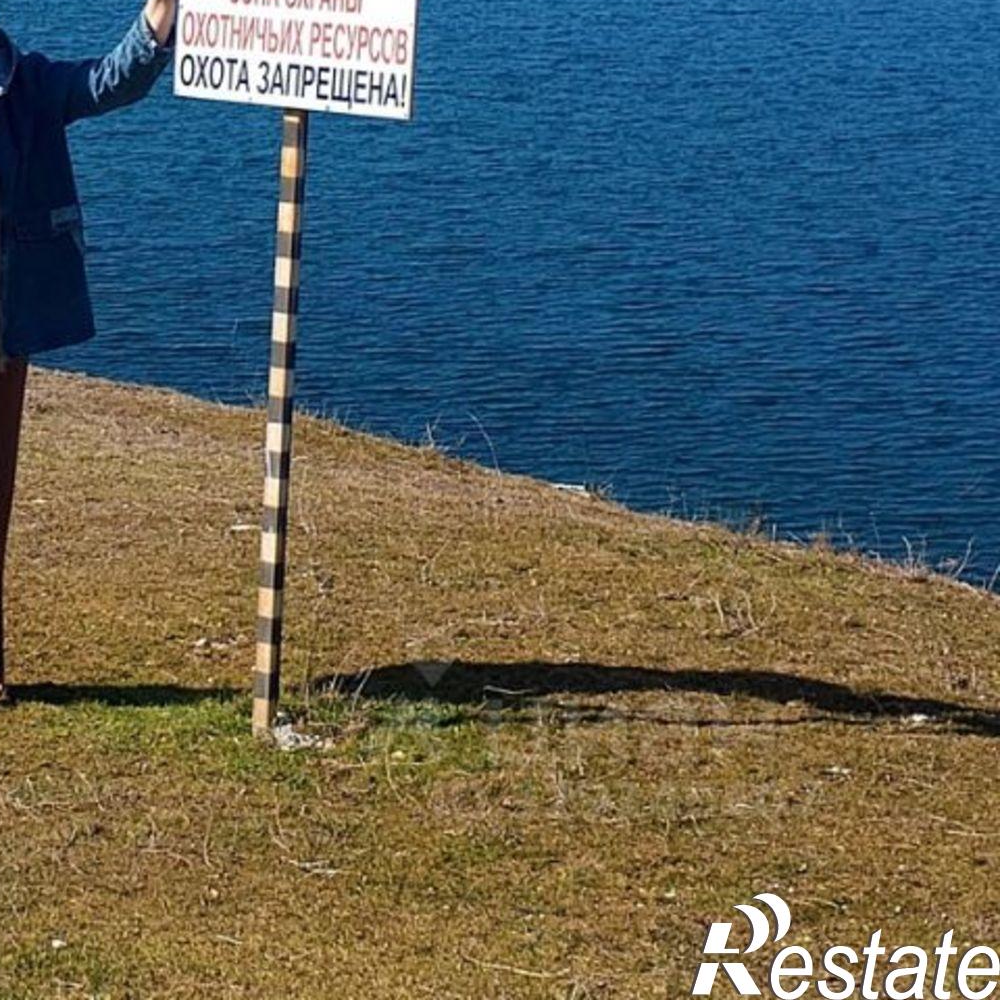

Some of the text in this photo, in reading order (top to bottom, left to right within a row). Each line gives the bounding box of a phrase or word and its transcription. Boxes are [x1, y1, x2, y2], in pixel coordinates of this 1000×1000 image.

[182, 12, 408, 65] ОХОТНИЧЬИХ РЕСУРСОВ
[180, 53, 407, 110] ОХОТА ЗАПРЕЩЕНА!
